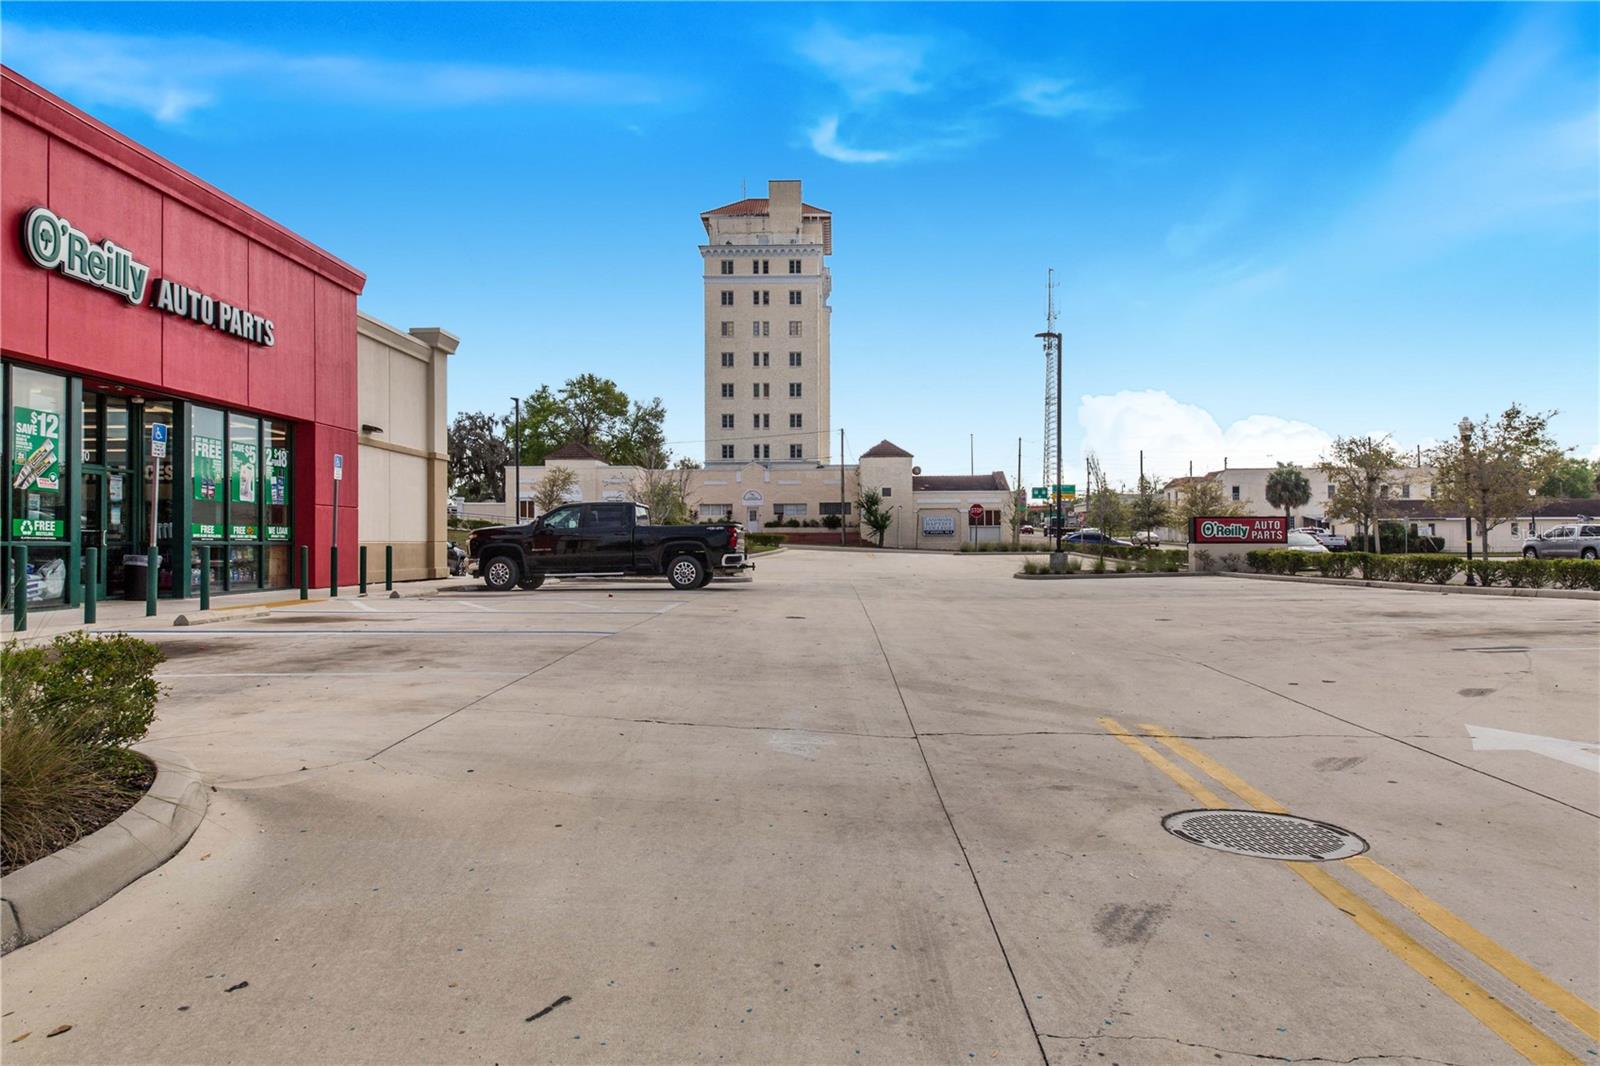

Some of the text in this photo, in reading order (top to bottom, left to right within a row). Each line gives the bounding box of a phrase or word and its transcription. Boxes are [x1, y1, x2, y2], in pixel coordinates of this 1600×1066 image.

[30, 210, 275, 347] O'Reilly AUTO PARTS
[16, 422, 38, 436] SAVE
[195, 442, 222, 459] FREE
[970, 506, 984, 514] STOP
[34, 520, 56, 531] FREE
[200, 525, 215, 534] FREE
[233, 526, 246, 535] FREE
[1201, 520, 1281, 539] O'Reilly AUTO
[1251, 530, 1283, 540] PARTS
